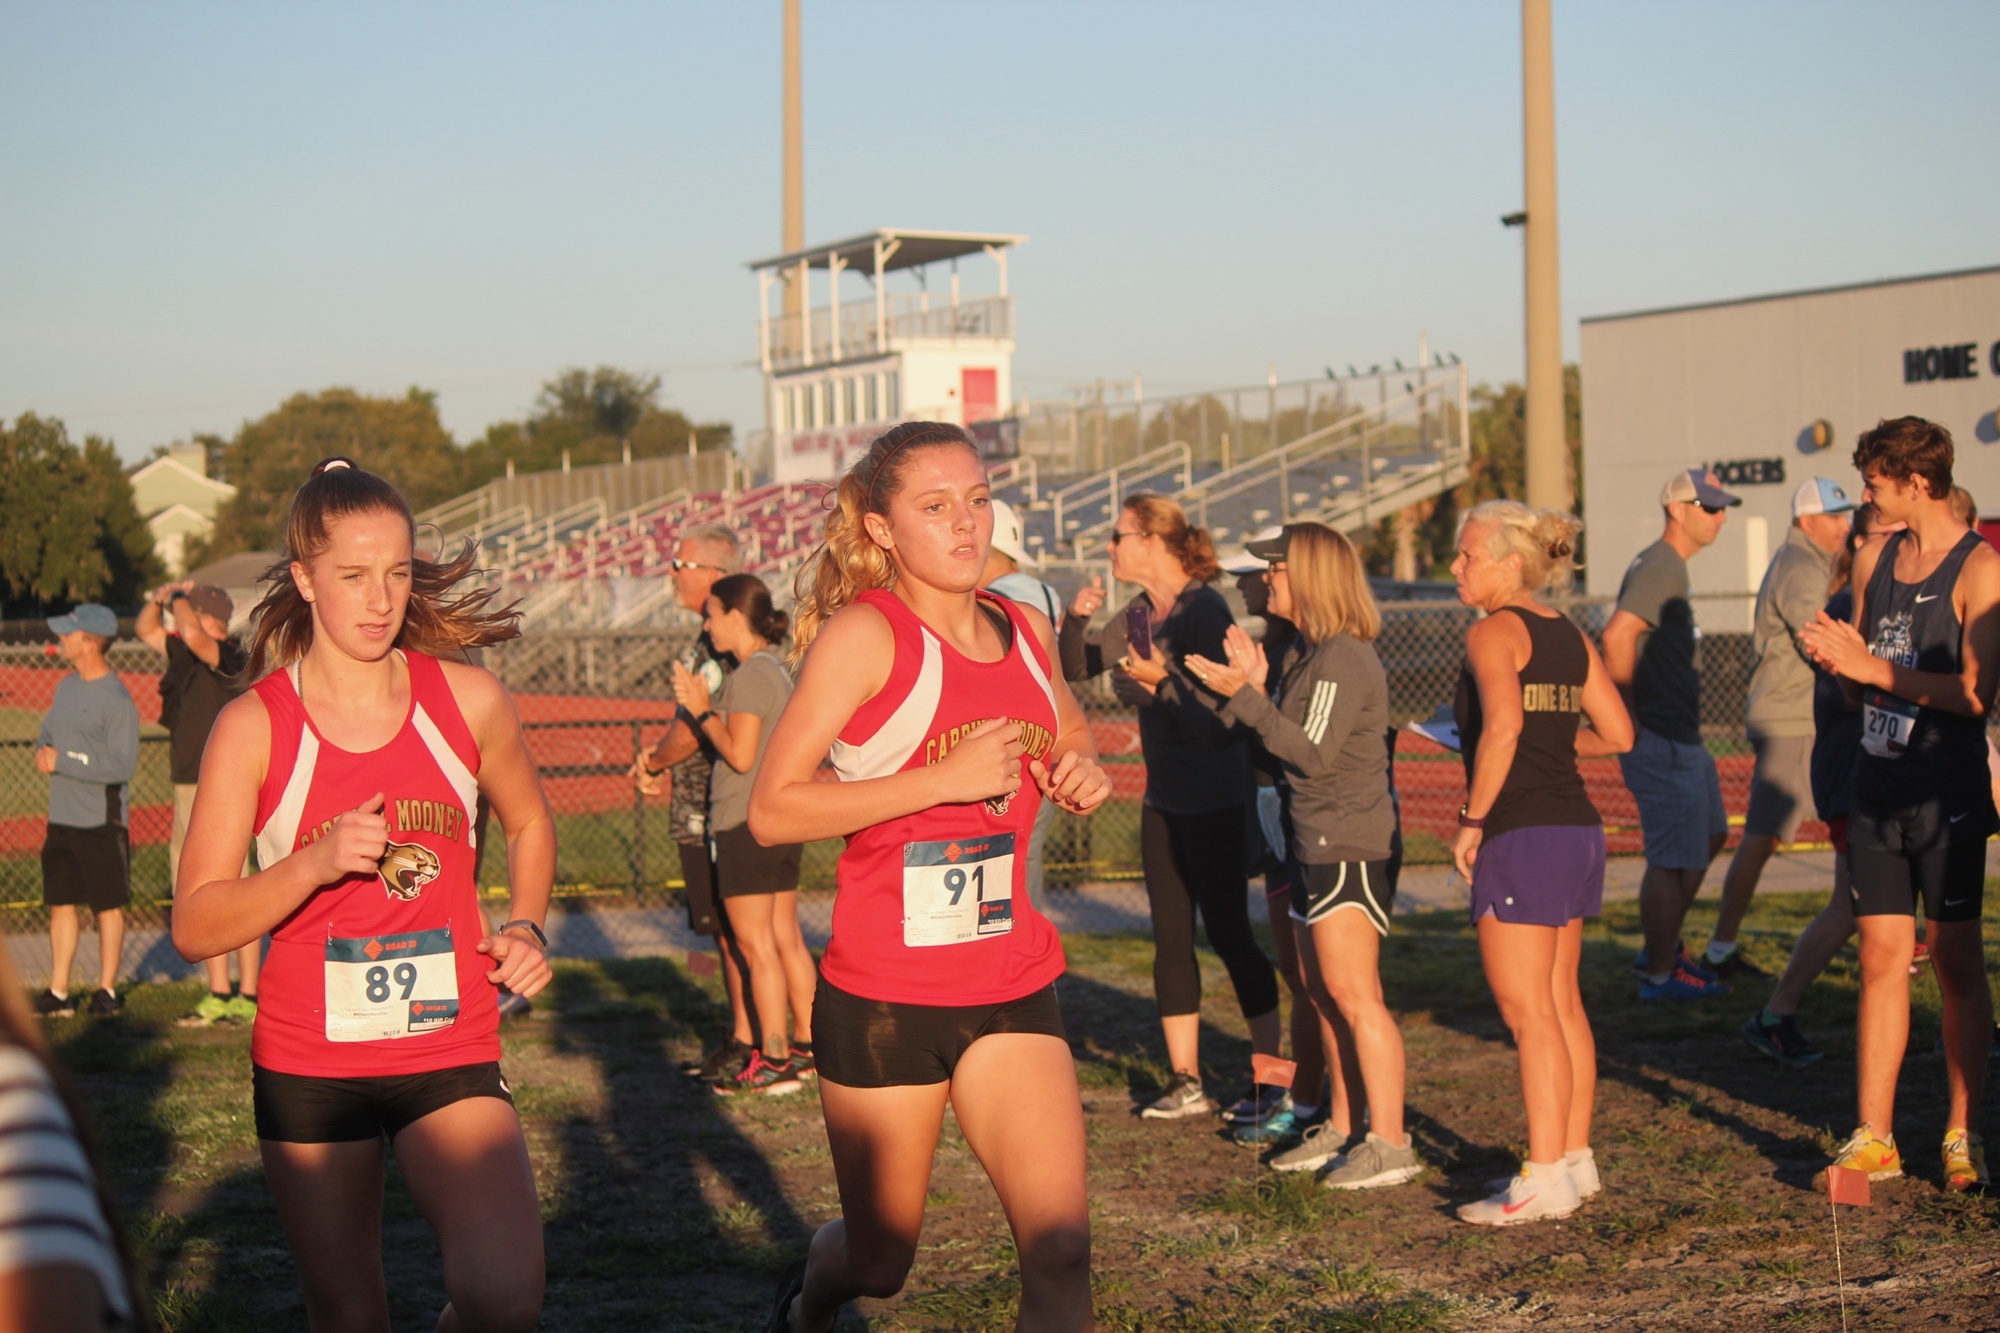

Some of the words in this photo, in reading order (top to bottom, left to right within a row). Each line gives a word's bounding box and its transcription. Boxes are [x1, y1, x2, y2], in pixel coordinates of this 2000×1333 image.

[1903, 341, 1978, 384] HOME
[1702, 456, 1785, 487] OCKERS
[1523, 682, 1557, 712] ONE
[1558, 683, 1569, 712] &
[1868, 709, 1899, 739] 270
[395, 799, 464, 843] MOONEY
[943, 864, 983, 906] 91
[385, 941, 407, 952] ROAD
[365, 962, 417, 1004] 89
